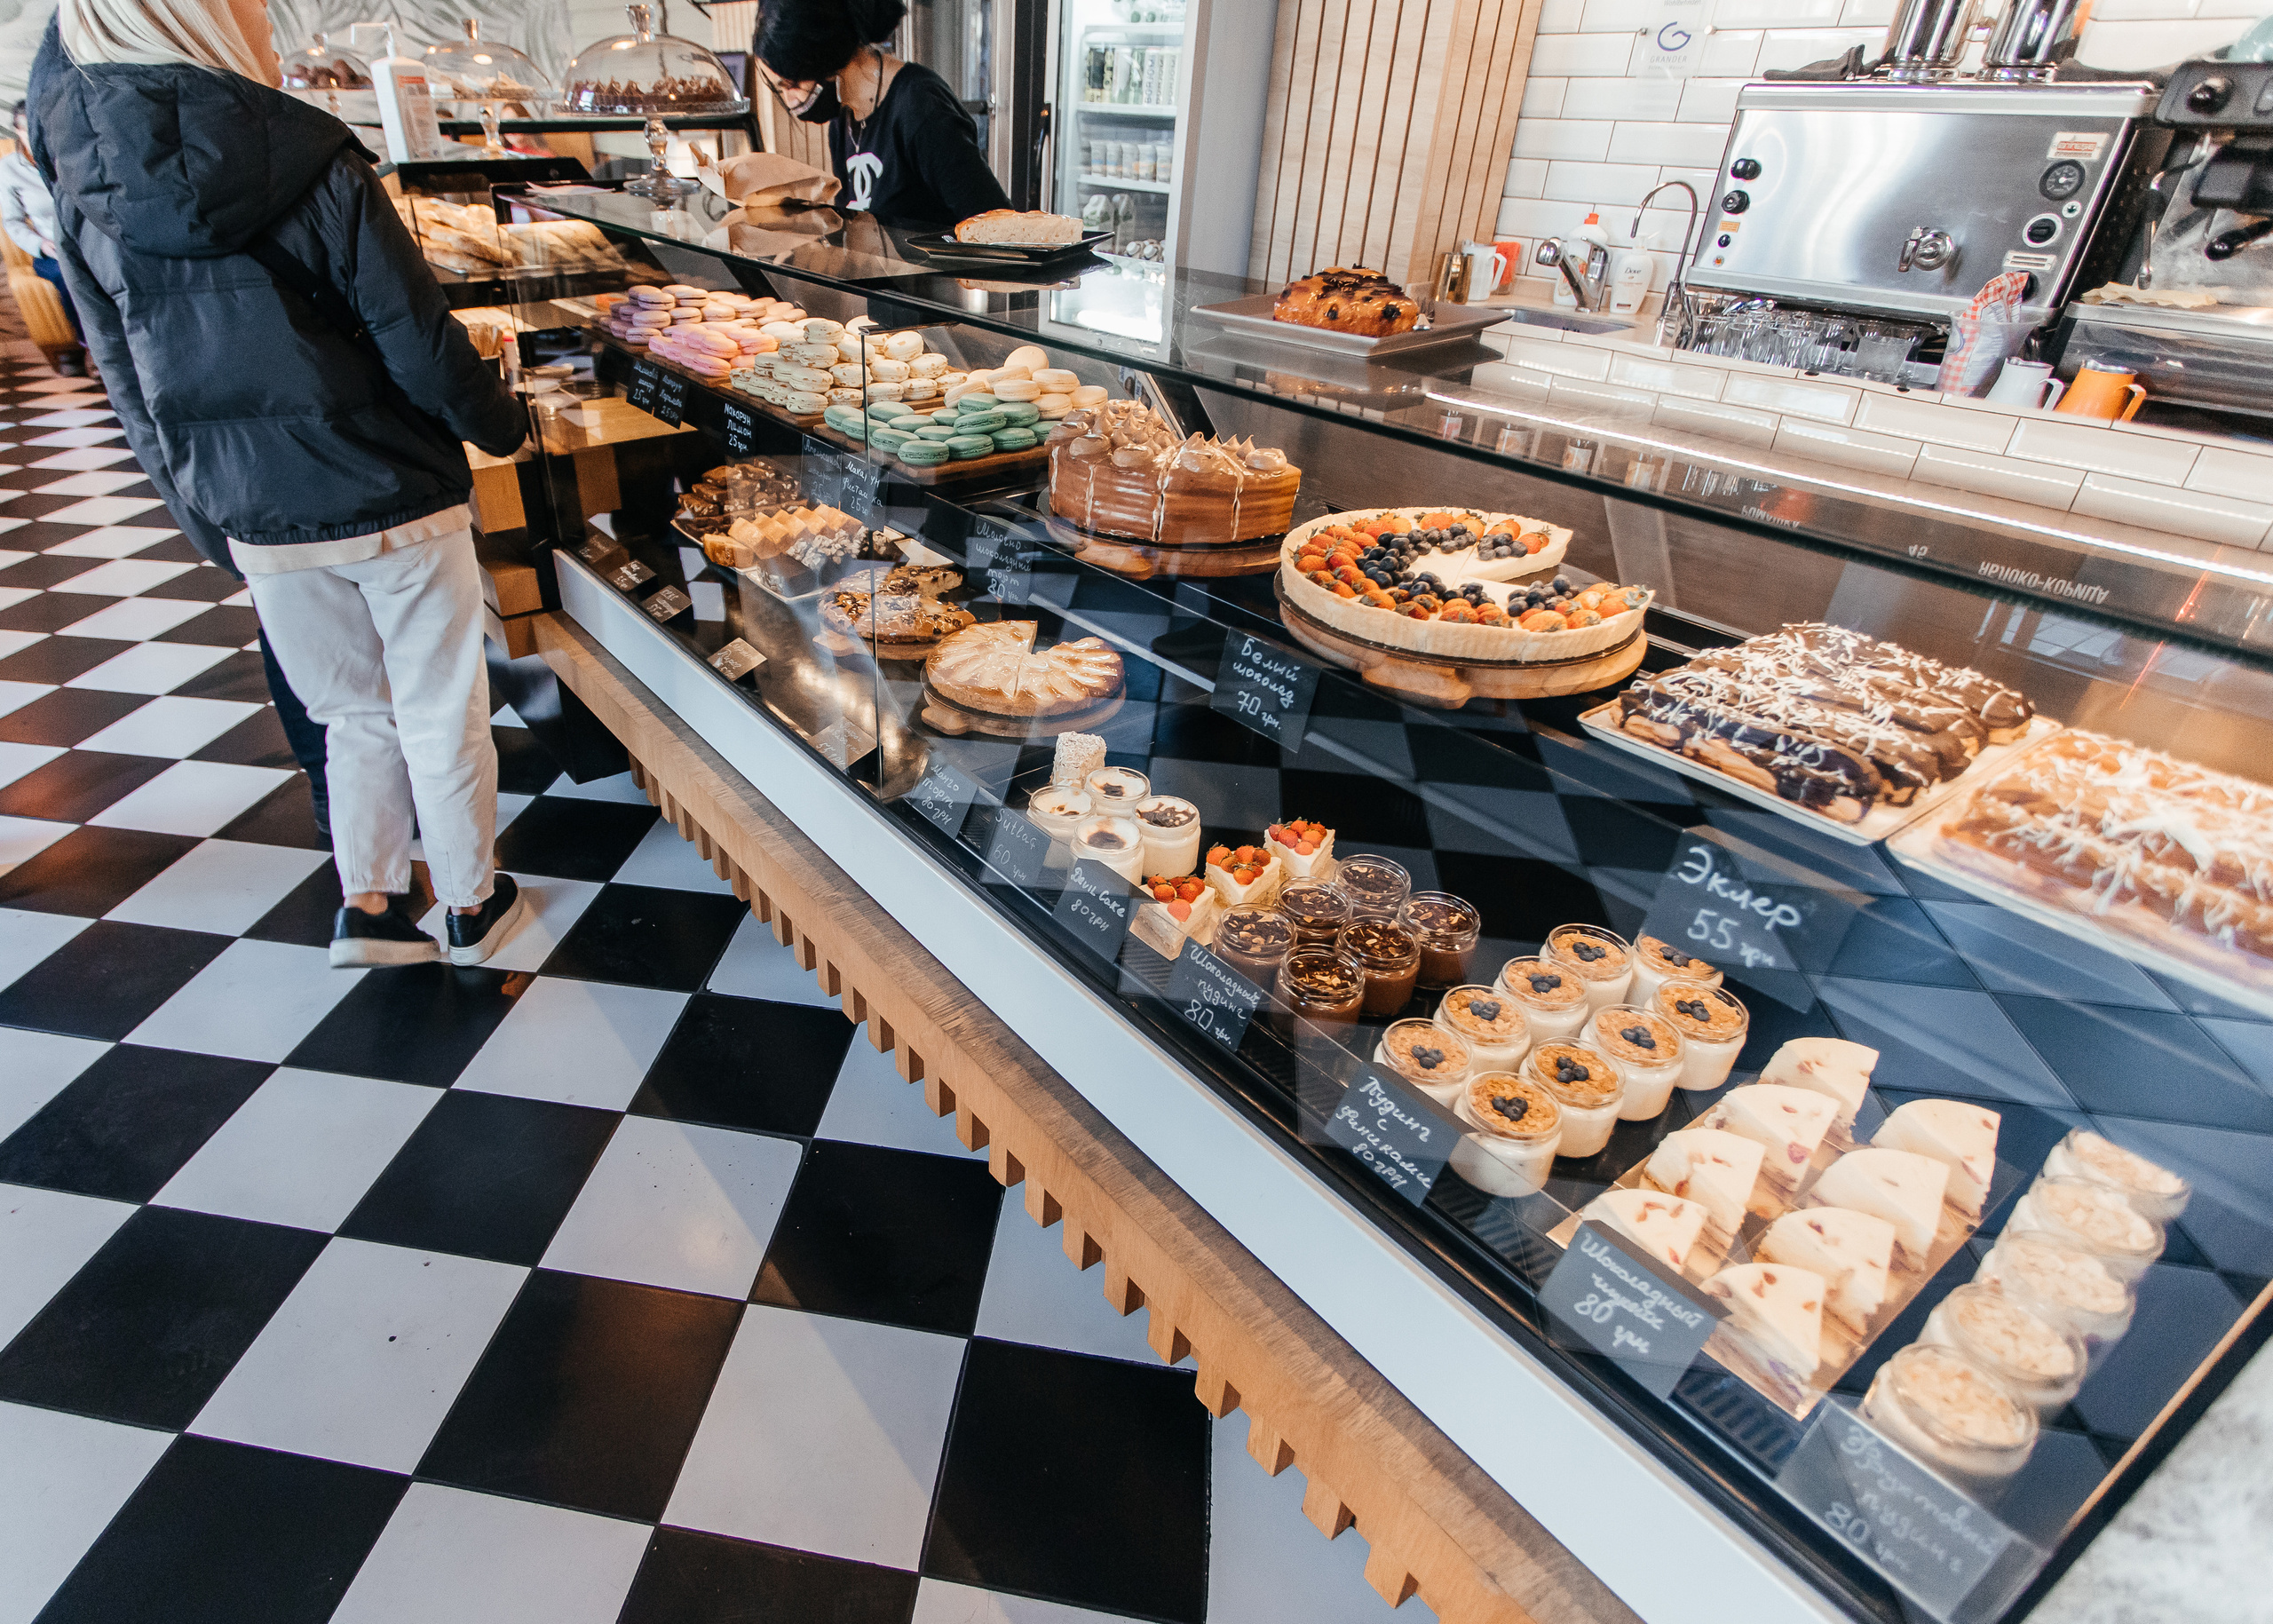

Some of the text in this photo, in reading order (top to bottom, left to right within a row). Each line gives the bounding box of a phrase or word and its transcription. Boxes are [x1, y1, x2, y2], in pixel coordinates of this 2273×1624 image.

[1650, 55, 1688, 64] GRANDER
[728, 433, 738, 448] 25
[851, 496, 862, 511] 25
[987, 578, 1005, 598] 80
[1237, 690, 1261, 716] 70
[922, 777, 954, 810] торт
[994, 844, 1010, 866] 60
[1687, 907, 1740, 949] 55
[1197, 978, 1247, 1020] пудинг
[1184, 999, 1215, 1031] 80
[1580, 1232, 1705, 1330] Шоколадный
[1572, 1293, 1614, 1324] 80
[1825, 1501, 1869, 1544] 80
